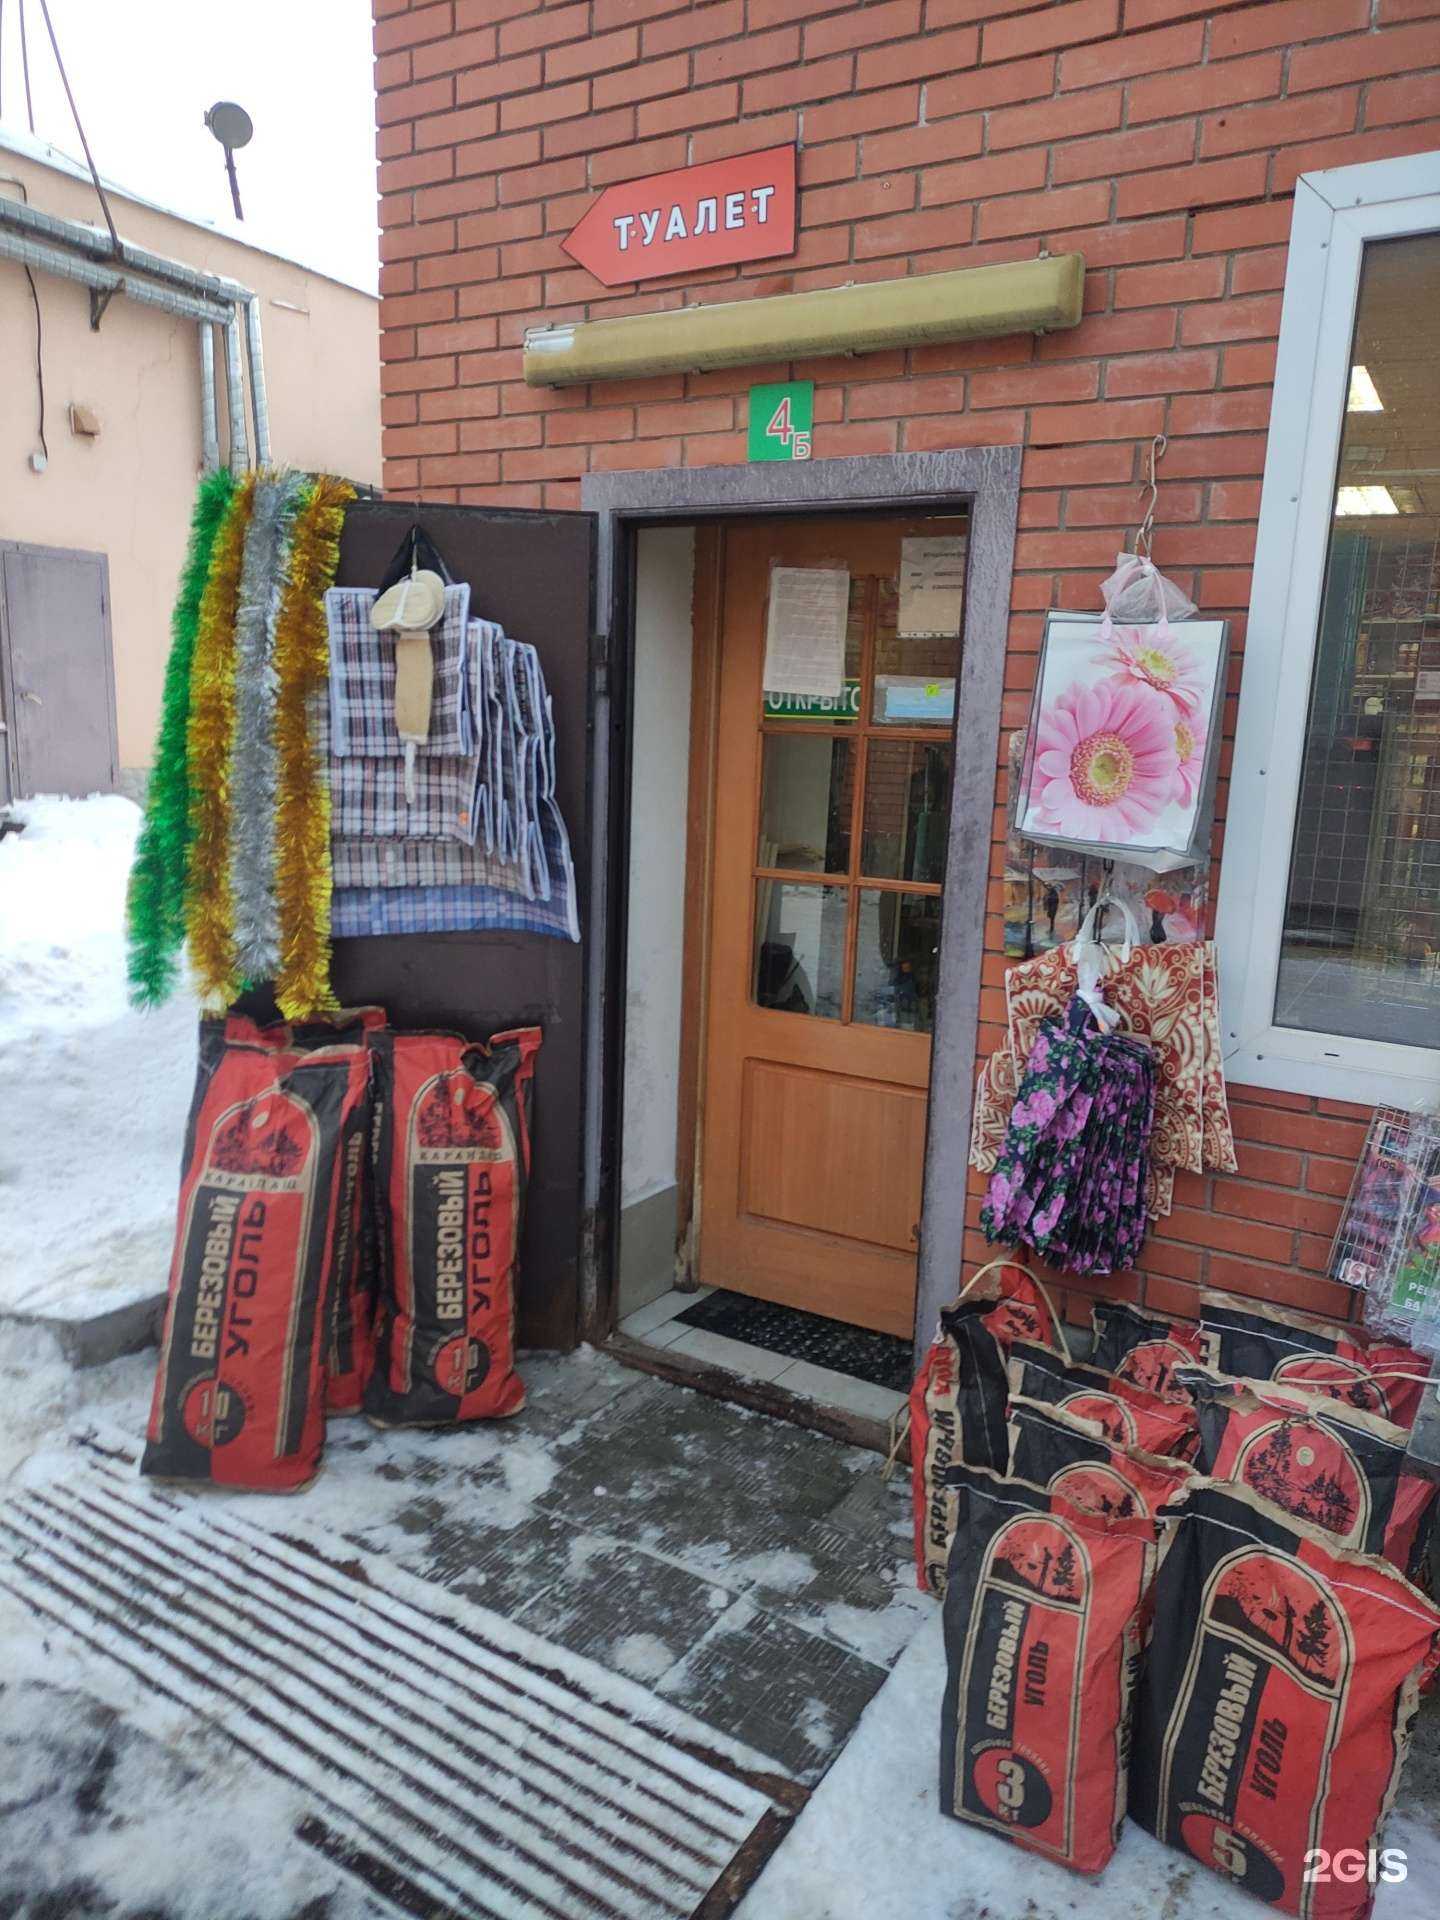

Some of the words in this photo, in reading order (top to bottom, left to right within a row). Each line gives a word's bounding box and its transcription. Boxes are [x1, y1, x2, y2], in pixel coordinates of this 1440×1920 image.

[613, 185, 775, 251] ТУАЛЕТ
[190, 1195, 241, 1358] БЕРЕЗОВЫЙ
[224, 1200, 266, 1359] УГОЛЬ
[432, 1171, 464, 1319] БЕРЕЗОВЫЙ
[472, 1171, 492, 1316] УГОЛЬ
[201, 1390, 230, 1420] 10
[986, 1599, 1026, 1731] БЕРЕЗОВЫЙ
[1023, 1639, 1049, 1707] УГОЛЬ
[1197, 1652, 1258, 1807] БЕРЕЗОВЫЙ
[1250, 1718, 1287, 1801] УГОЛЬ
